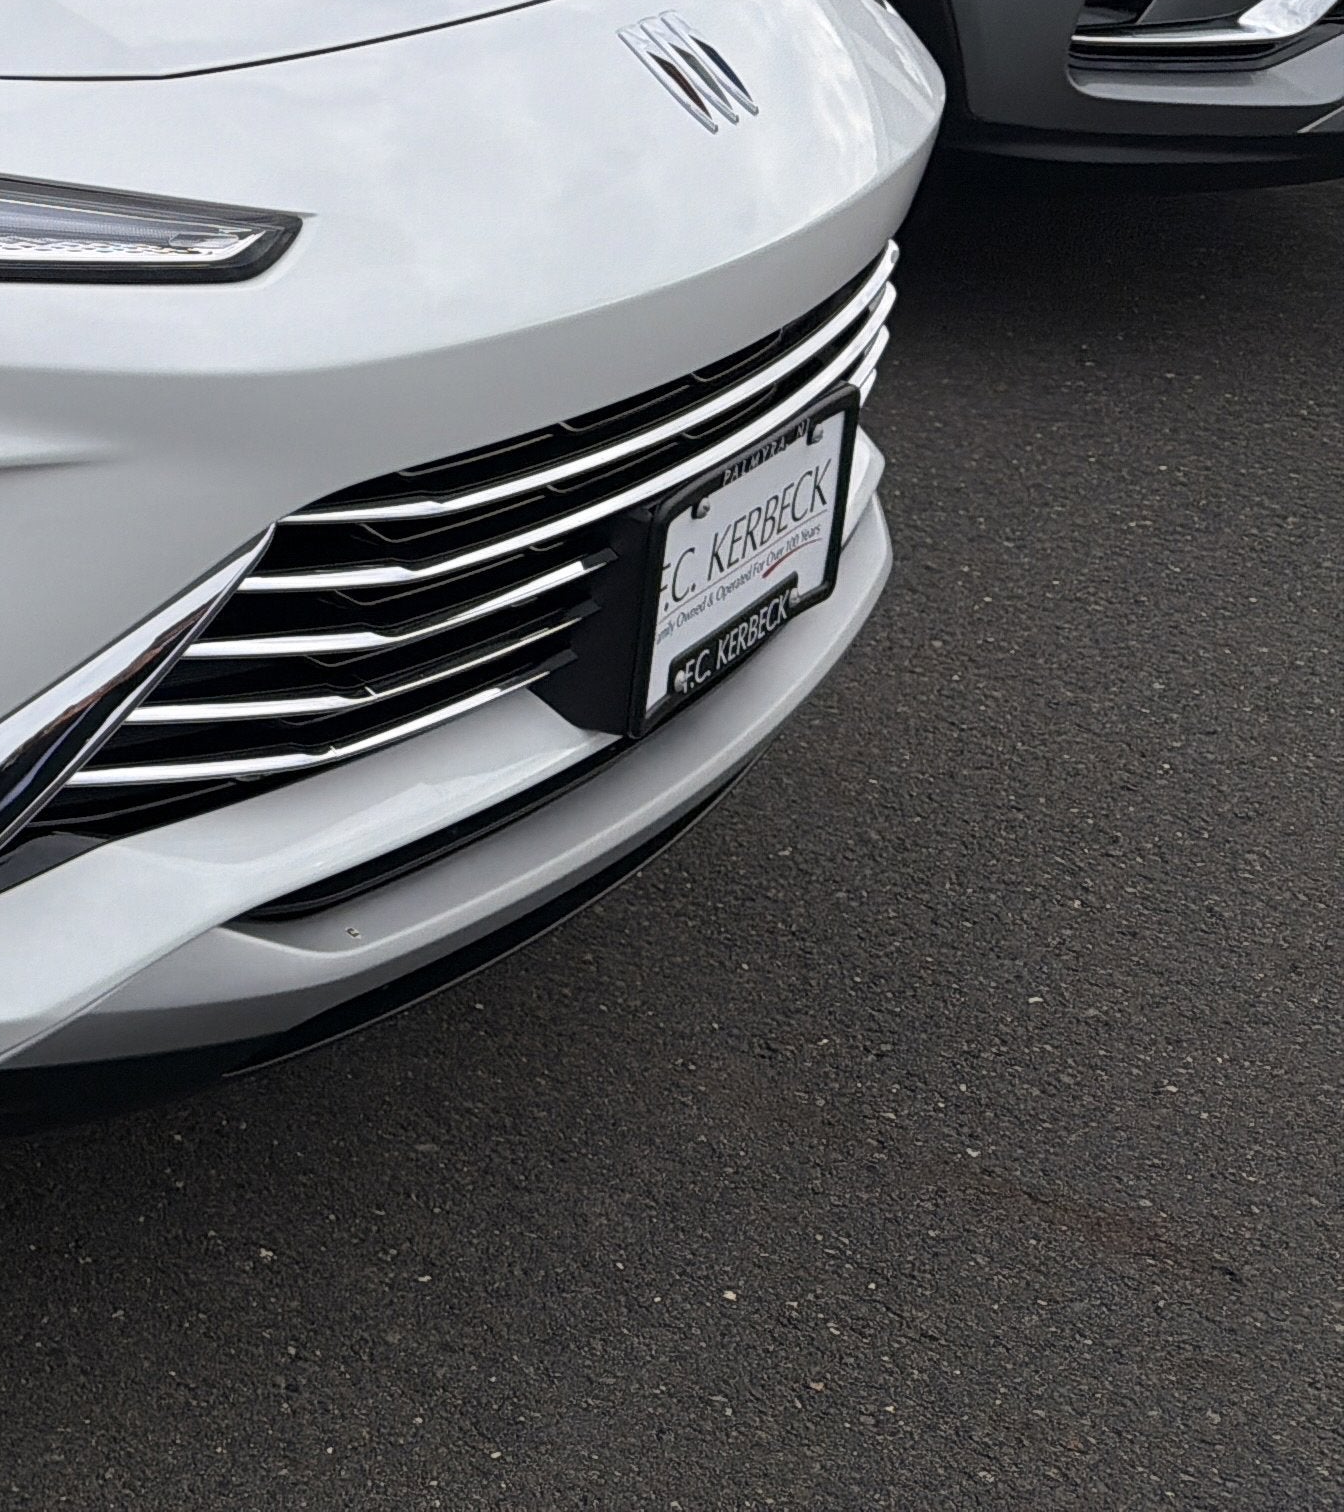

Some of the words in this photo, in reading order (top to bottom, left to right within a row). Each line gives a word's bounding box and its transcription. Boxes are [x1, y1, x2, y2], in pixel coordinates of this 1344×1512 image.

[708, 458, 832, 582] KERBECK
[715, 565, 753, 602] Operated
[753, 559, 765, 575] For
[766, 545, 785, 567] Over
[786, 533, 800, 552] 100
[800, 523, 822, 543] Years
[716, 589, 791, 670] KERBECK
